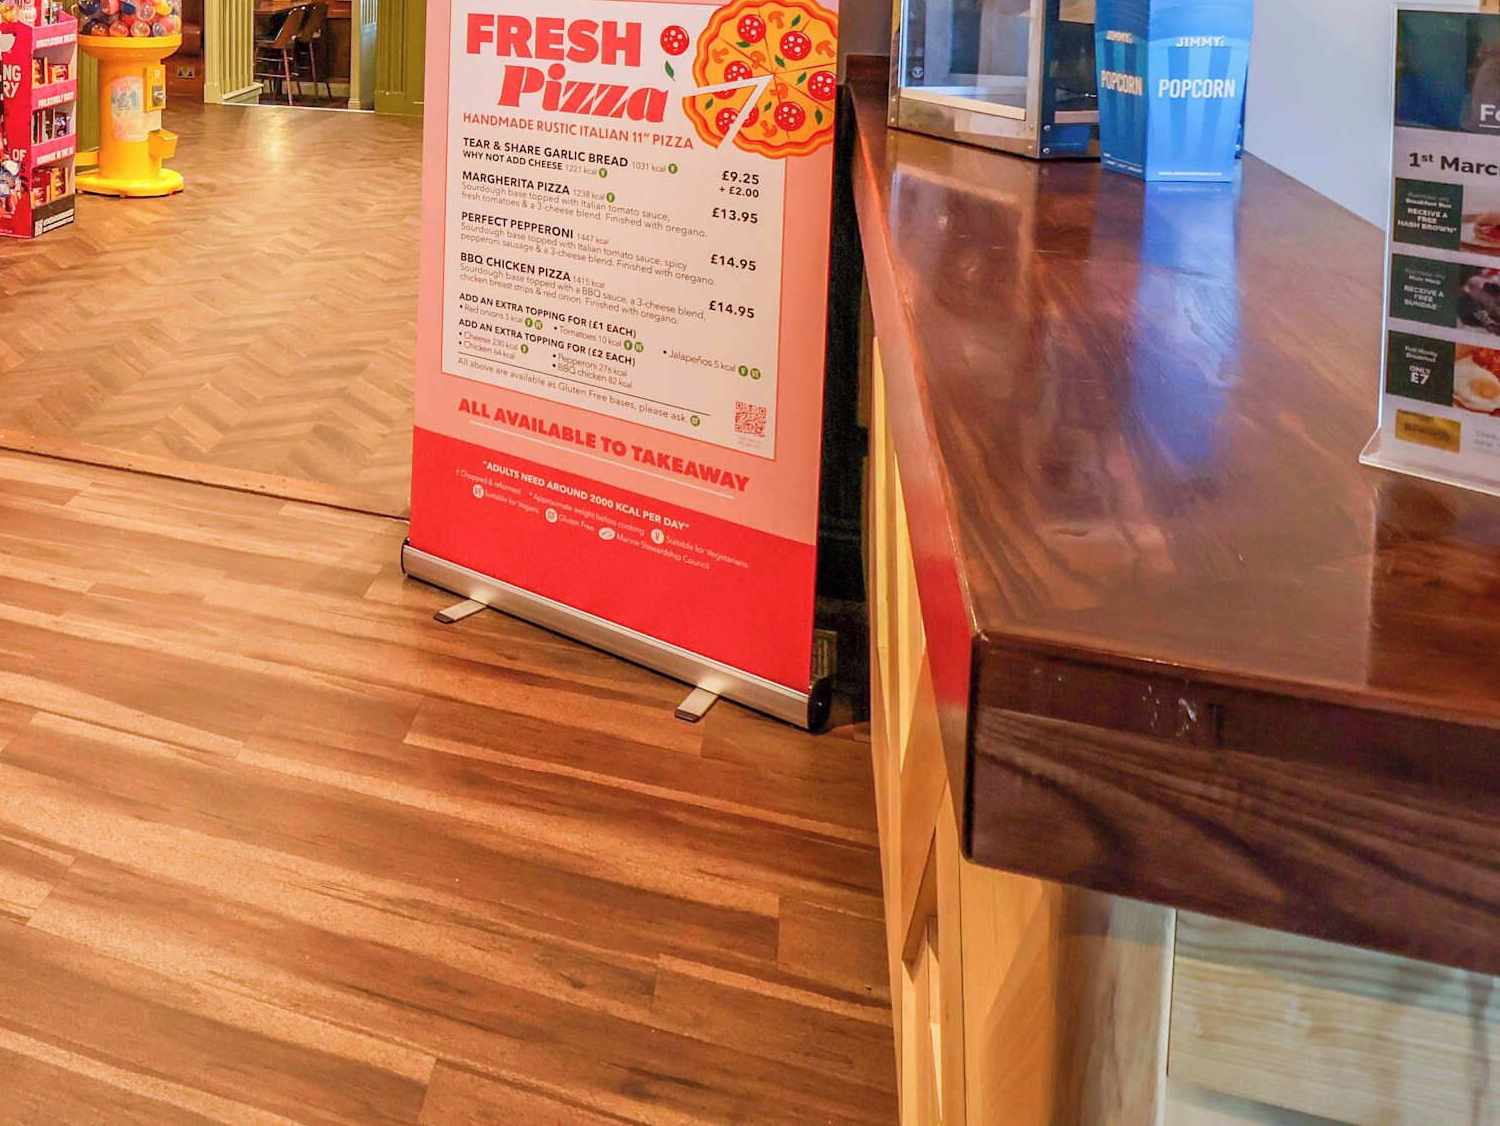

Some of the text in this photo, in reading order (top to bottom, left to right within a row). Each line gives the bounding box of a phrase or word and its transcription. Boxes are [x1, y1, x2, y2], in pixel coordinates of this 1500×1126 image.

[466, 13, 642, 67] FRESH
[497, 63, 669, 123] Pizza
[1101, 70, 1143, 96] POPCORN
[1158, 78, 1236, 99] POPCORN
[463, 112, 534, 131] HANDMADE
[536, 120, 577, 136] RUSTIC
[579, 126, 629, 143] ITALIAN
[652, 134, 694, 149] PIZZA
[12, 149, 27, 162] OF
[462, 150, 563, 170] WHY NOT ADD CHEESE
[463, 137, 490, 150] TEAR
[493, 141, 501, 151] &
[504, 142, 541, 156] SHARE
[544, 147, 586, 162] GARLIC
[588, 153, 629, 167] BREAD
[1409, 152, 1500, 176] 1st Marc
[462, 171, 570, 195] MARGHERITA PIZZA
[722, 170, 760, 185] £9.25
[729, 185, 760, 198] £2.00
[461, 211, 573, 239] PERFECT PEPPERONI
[711, 207, 758, 224] £13.95
[460, 252, 571, 282] BBQ CHICKEN PIZZA
[710, 254, 757, 272] £14.95
[459, 292, 636, 339] ADD AN EXTRA TOPPING FOR (£1 EACH)
[709, 300, 755, 319] £14.95
[459, 318, 636, 367] ADD AN EXTRA TOPPING FOR (£2 EACH)
[470, 360, 497, 373] above
[510, 369, 546, 386] available
[558, 382, 587, 396] Gluten
[589, 390, 607, 402] Free
[639, 404, 669, 419] please
[1410, 372, 1430, 385] £7
[458, 398, 750, 492] ALL AVAILABLE TO TAKEAWAY
[520, 472, 545, 488] NEED
[546, 480, 587, 500] AROUND
[589, 493, 614, 509] 2000
[615, 501, 641, 518] KCAL
[642, 509, 662, 524] PER
